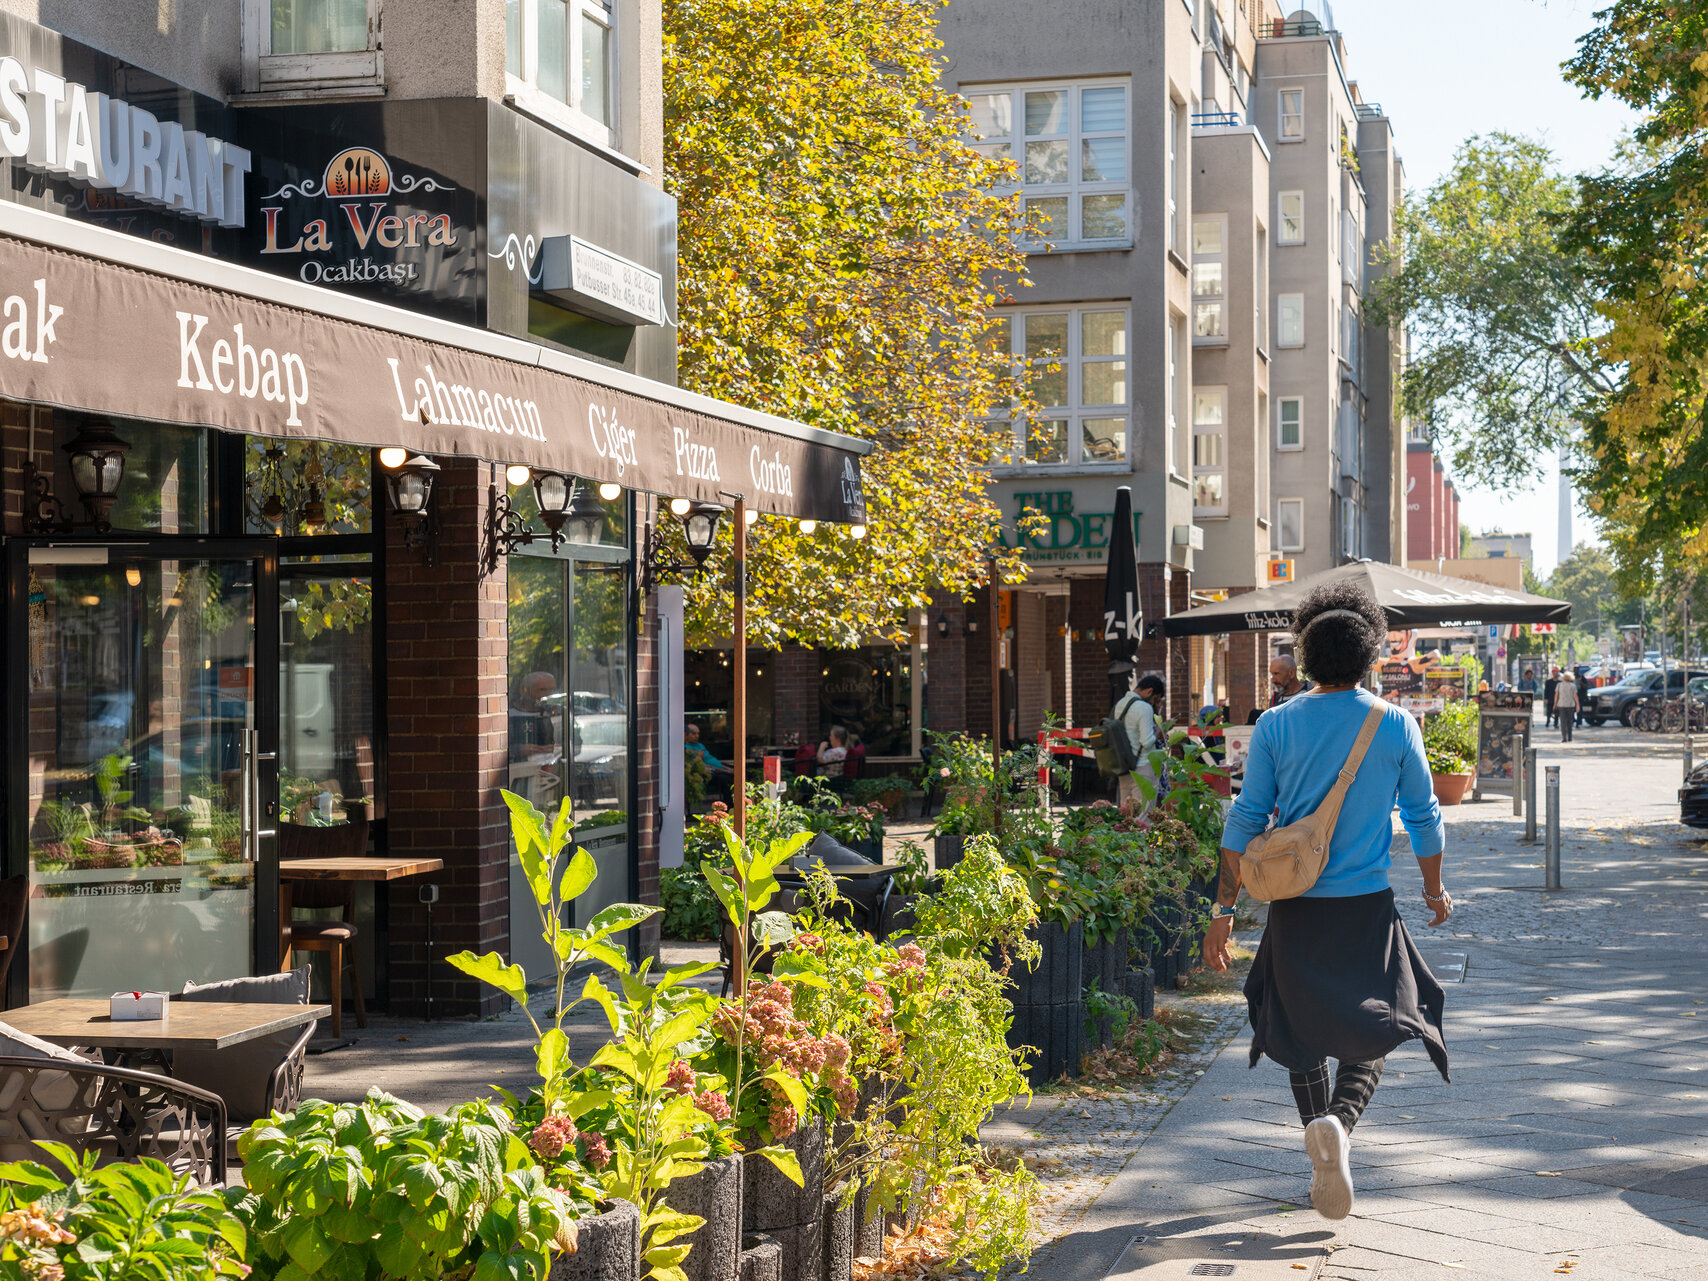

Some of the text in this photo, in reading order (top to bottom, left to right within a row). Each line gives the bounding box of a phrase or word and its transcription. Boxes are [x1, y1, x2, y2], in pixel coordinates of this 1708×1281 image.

[260, 203, 457, 254] La Vera
[300, 257, 418, 285] Ocakbaşı
[577, 267, 610, 296] Putbusser
[612, 282, 623, 301] Str.
[2, 278, 64, 364] ak
[176, 311, 309, 427] Kebap
[387, 358, 547, 442] Lahmacun
[673, 427, 720, 482] Pizza
[750, 444, 793, 497] Corba
[1013, 491, 1074, 515] THE
[1272, 563, 1287, 577] EC
